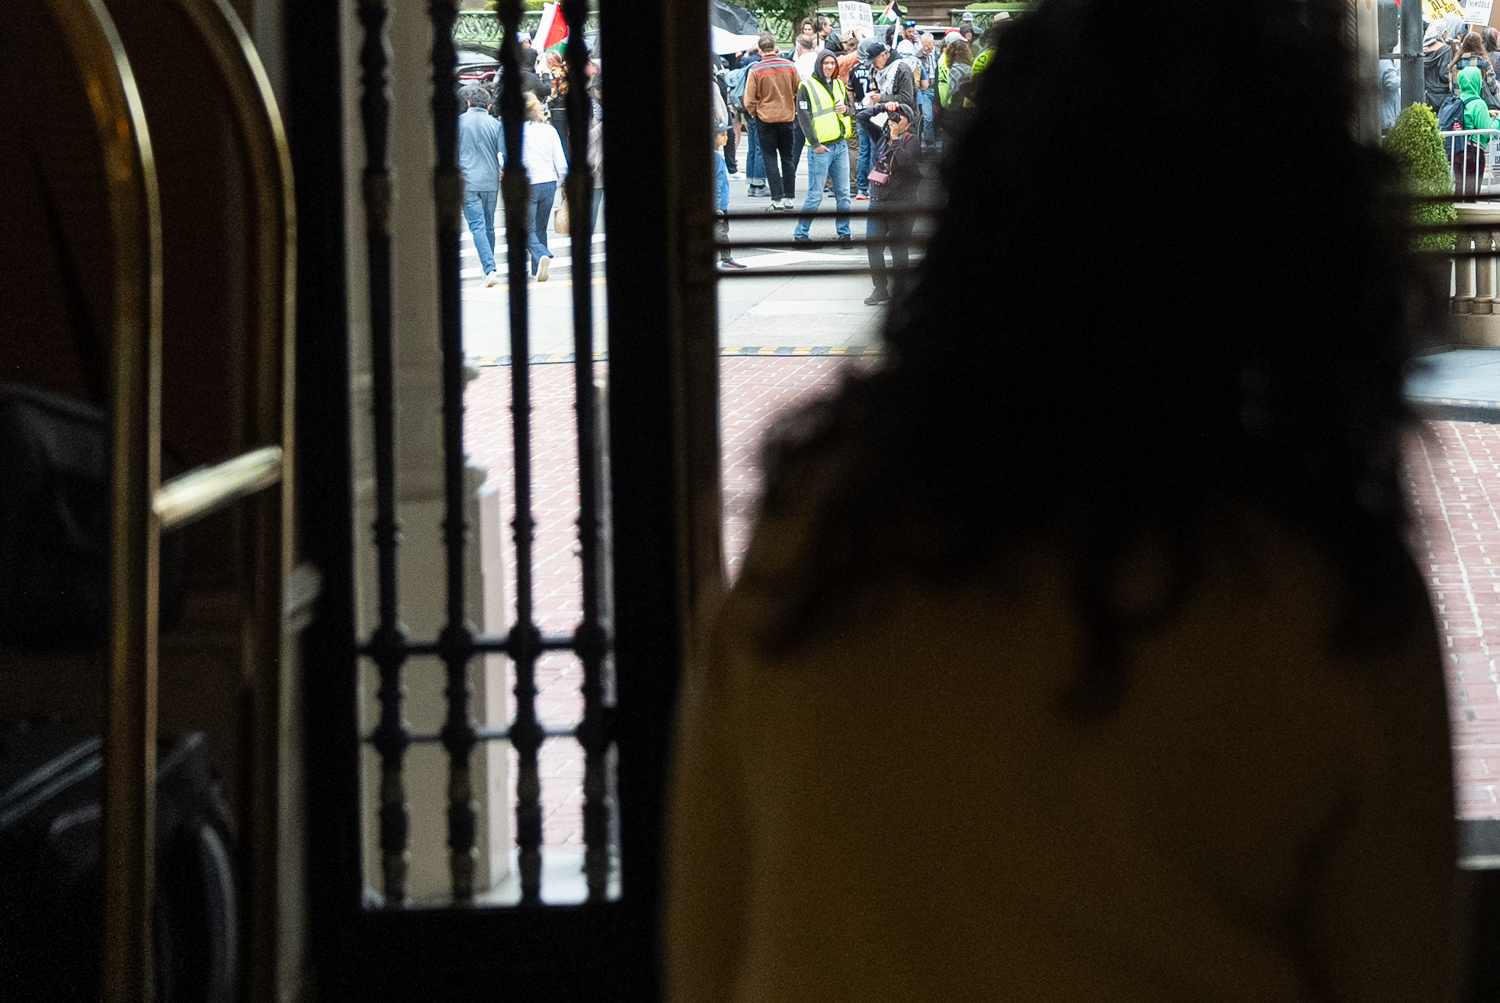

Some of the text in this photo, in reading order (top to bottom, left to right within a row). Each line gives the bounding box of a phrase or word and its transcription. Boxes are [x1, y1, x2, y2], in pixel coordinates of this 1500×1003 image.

[859, 5, 870, 13] ALL
[1444, 3, 1456, 14] AID
[860, 13, 870, 22] AID
